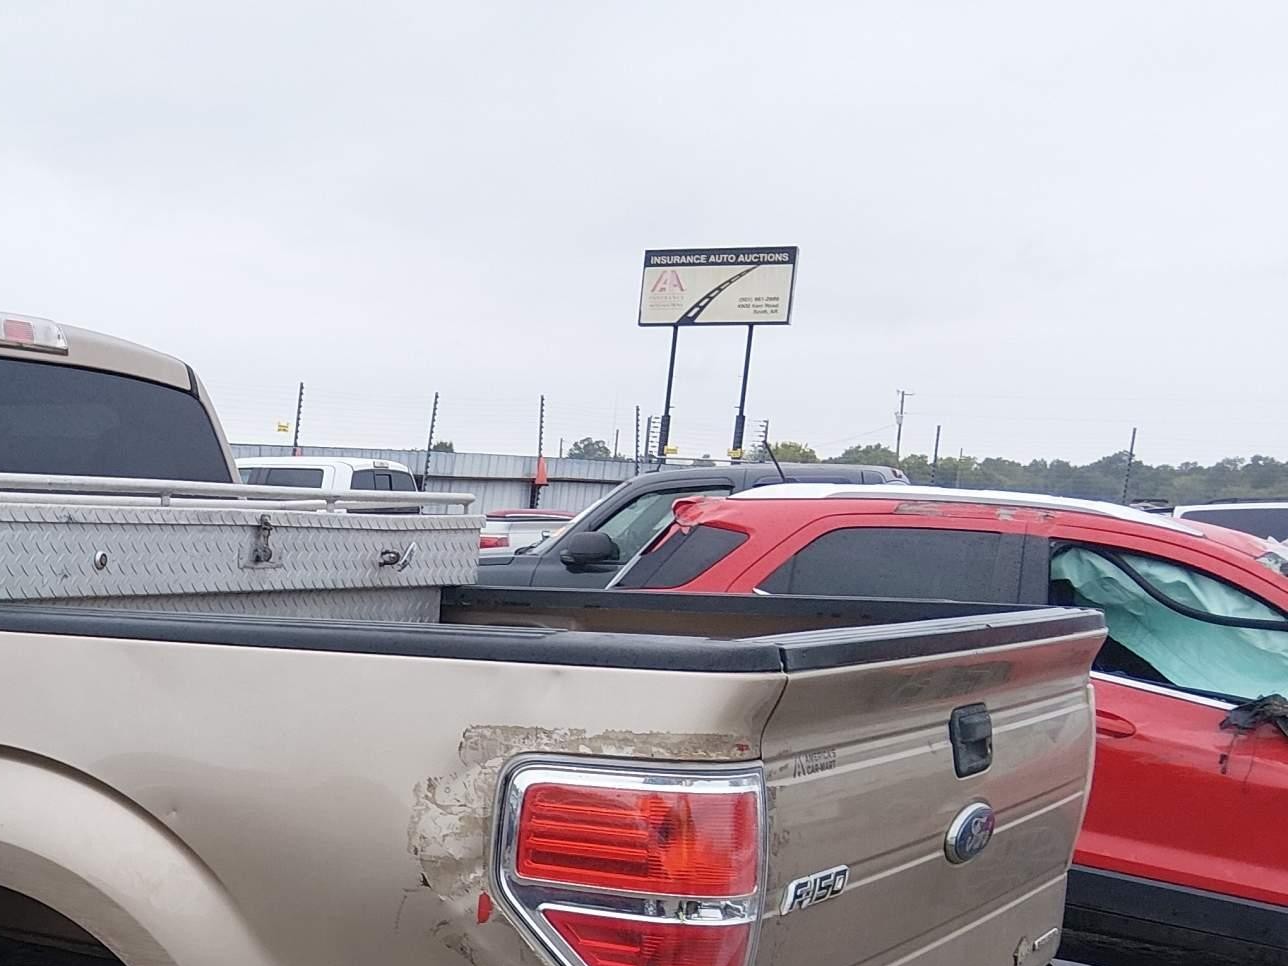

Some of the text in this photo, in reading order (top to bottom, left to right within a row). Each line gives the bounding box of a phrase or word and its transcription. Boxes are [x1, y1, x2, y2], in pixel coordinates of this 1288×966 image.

[650, 252, 789, 265] INSURANCE AUTO AUCTIONS
